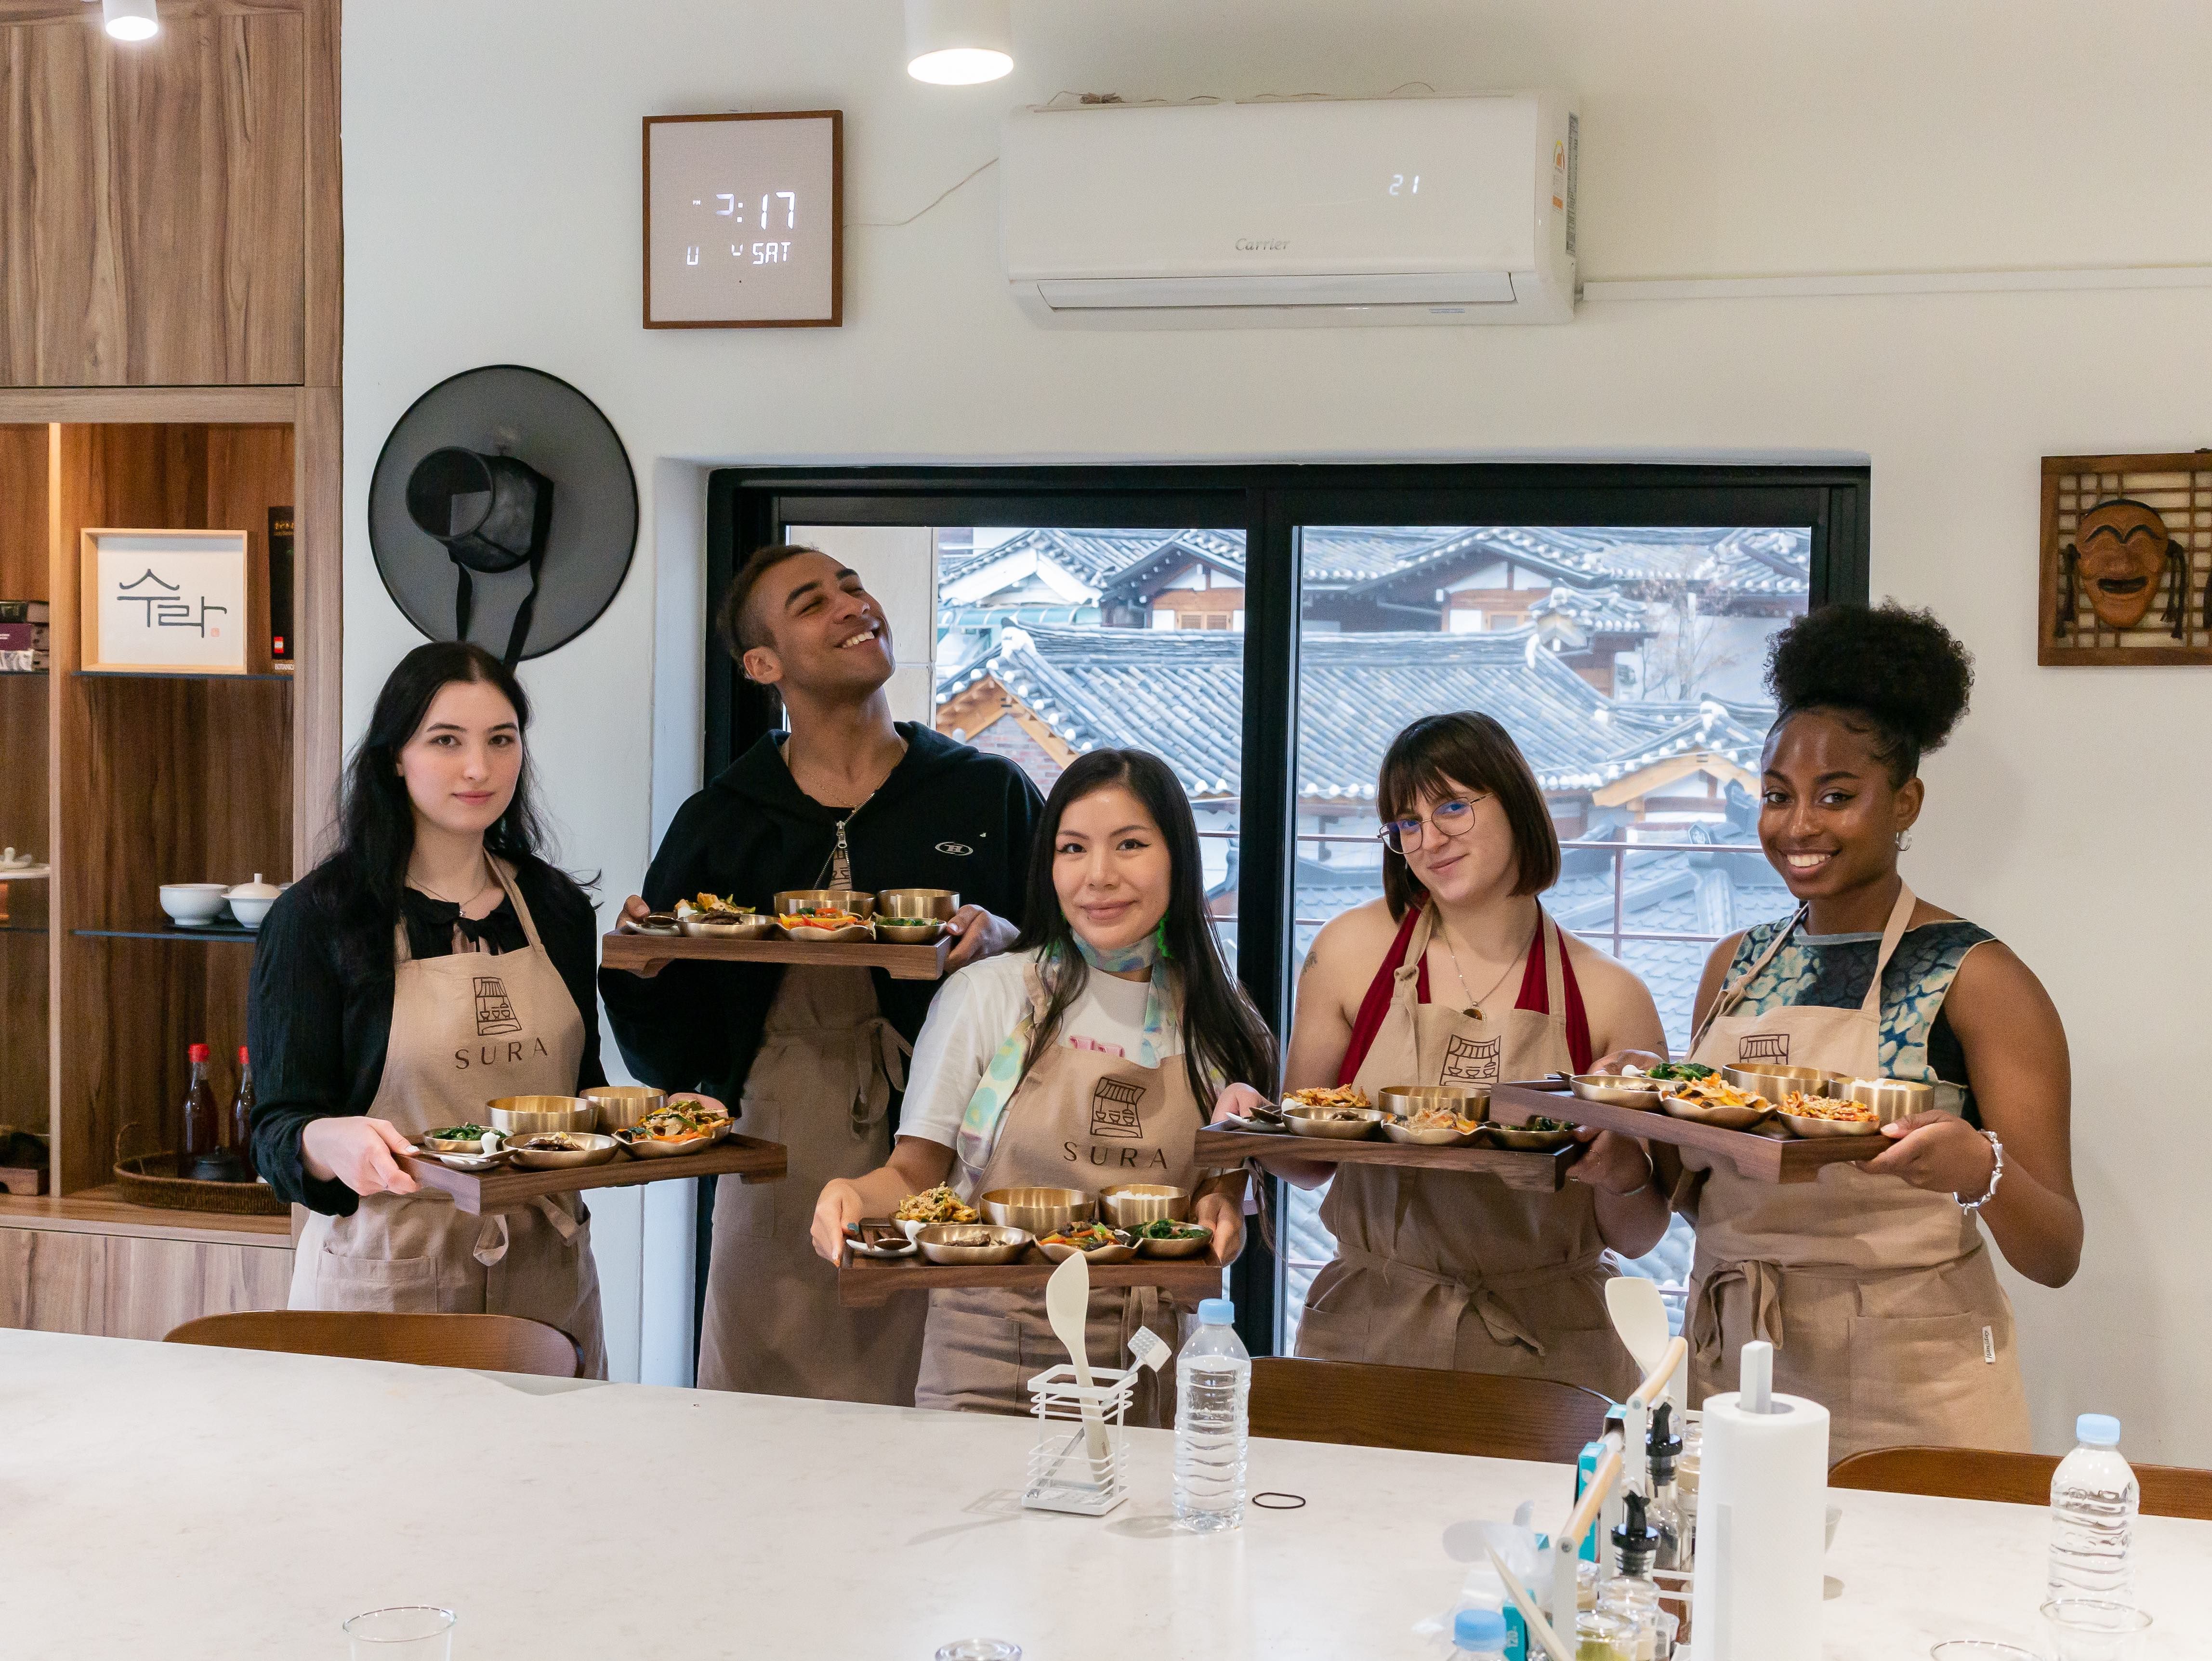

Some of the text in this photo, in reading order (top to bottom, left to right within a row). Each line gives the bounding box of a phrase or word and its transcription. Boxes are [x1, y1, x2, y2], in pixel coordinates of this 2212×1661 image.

[1389, 174, 1419, 196] 21
[752, 242, 791, 264] SAT
[1235, 237, 1291, 250] Carrier
[117, 568, 227, 638] 수라
[455, 1037, 548, 1069] SURA
[1063, 1141, 1168, 1170] SURA
